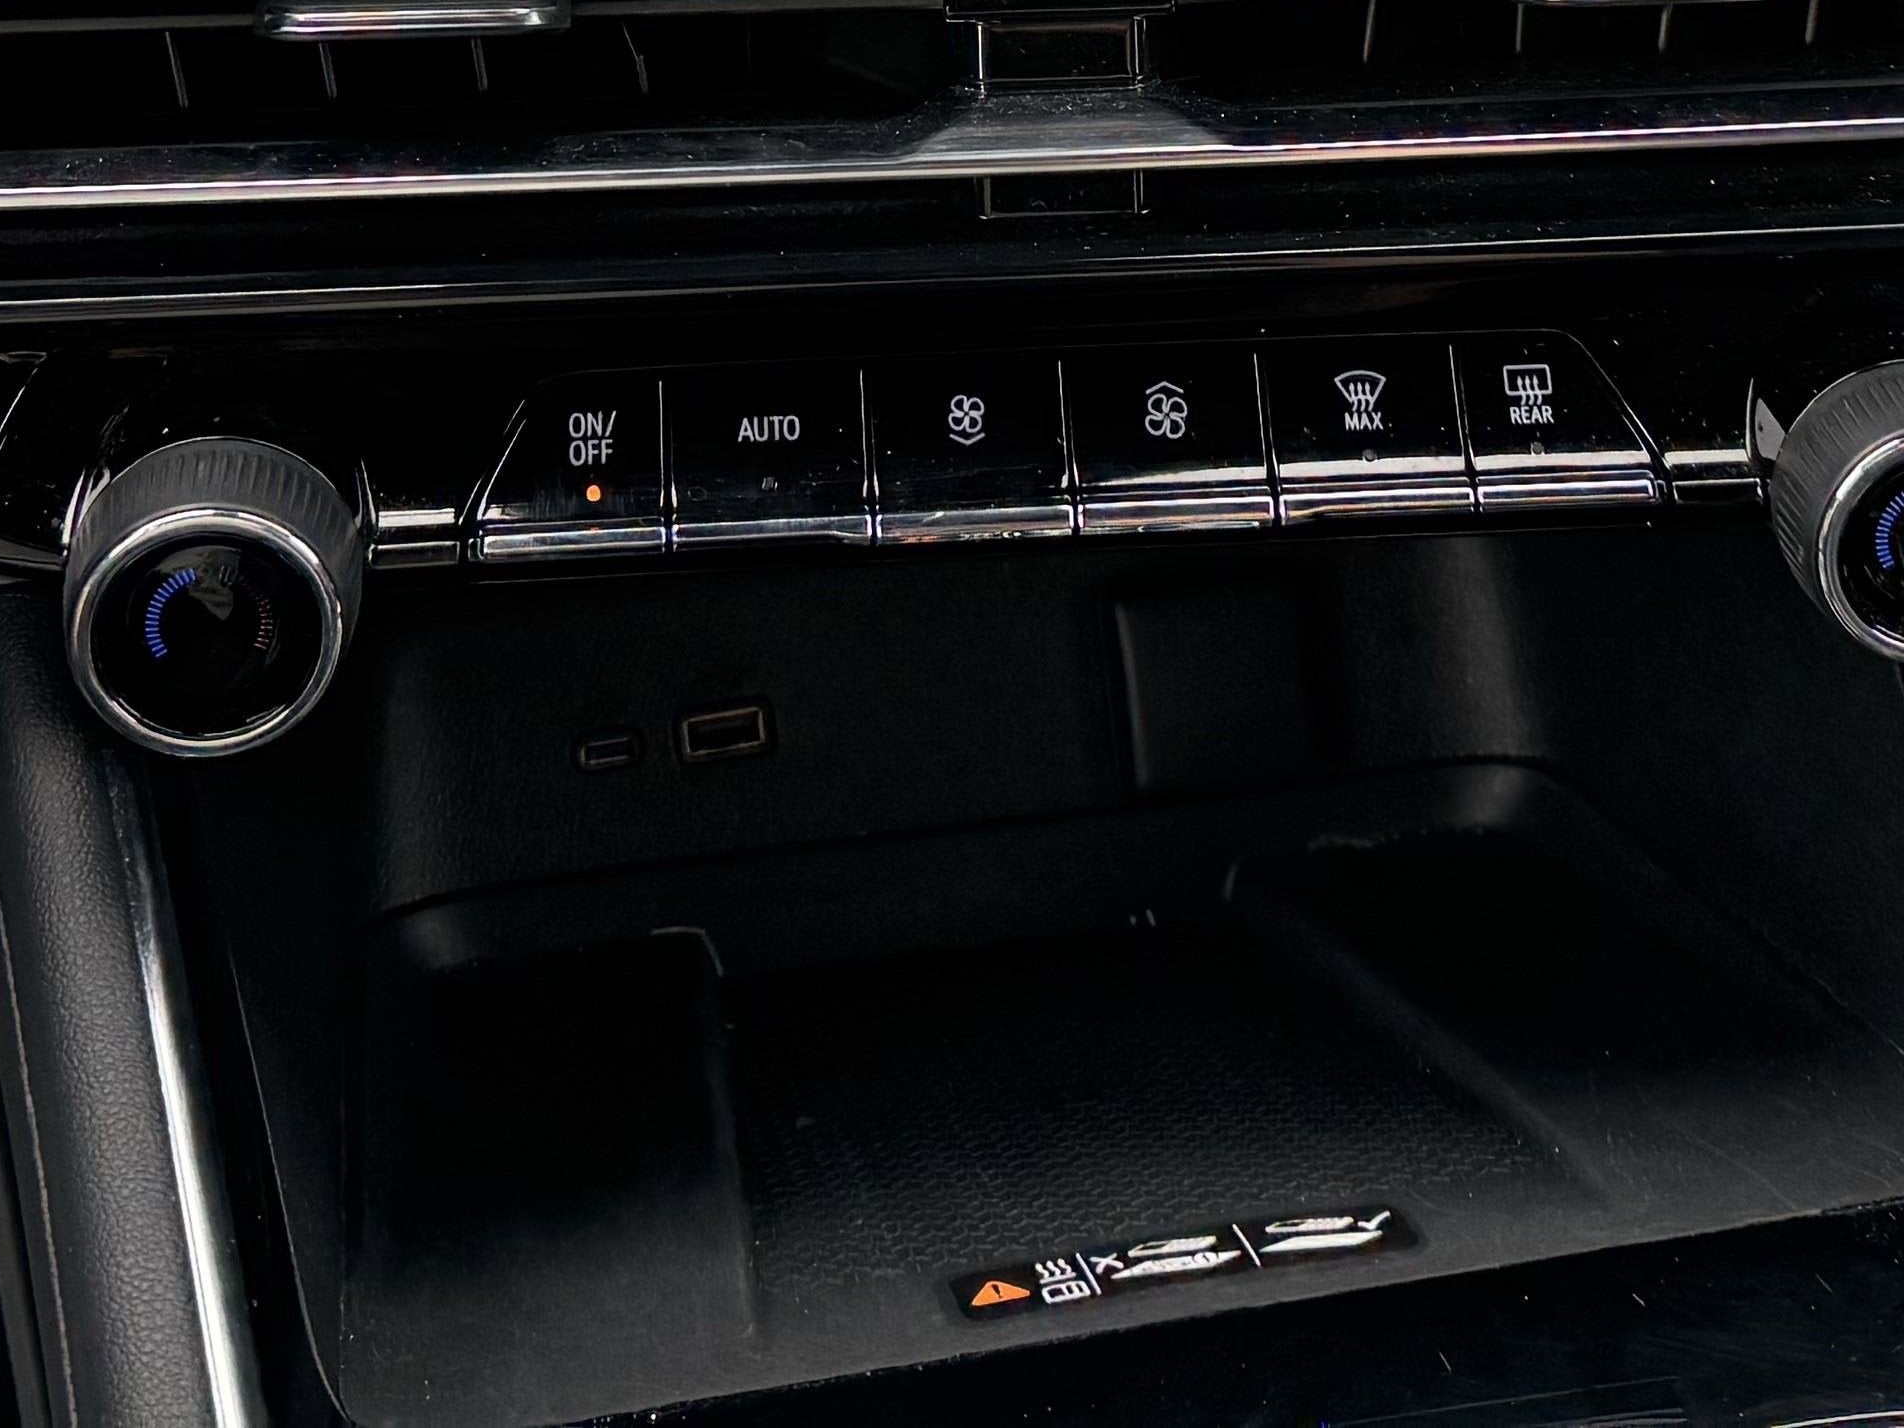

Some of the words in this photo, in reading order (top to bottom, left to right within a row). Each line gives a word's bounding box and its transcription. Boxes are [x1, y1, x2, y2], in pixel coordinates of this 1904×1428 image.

[568, 410, 617, 438] ON/
[737, 415, 800, 443] AUTO
[1344, 412, 1384, 432] MAX
[1509, 405, 1555, 425] REAR
[569, 438, 613, 467] OFF
